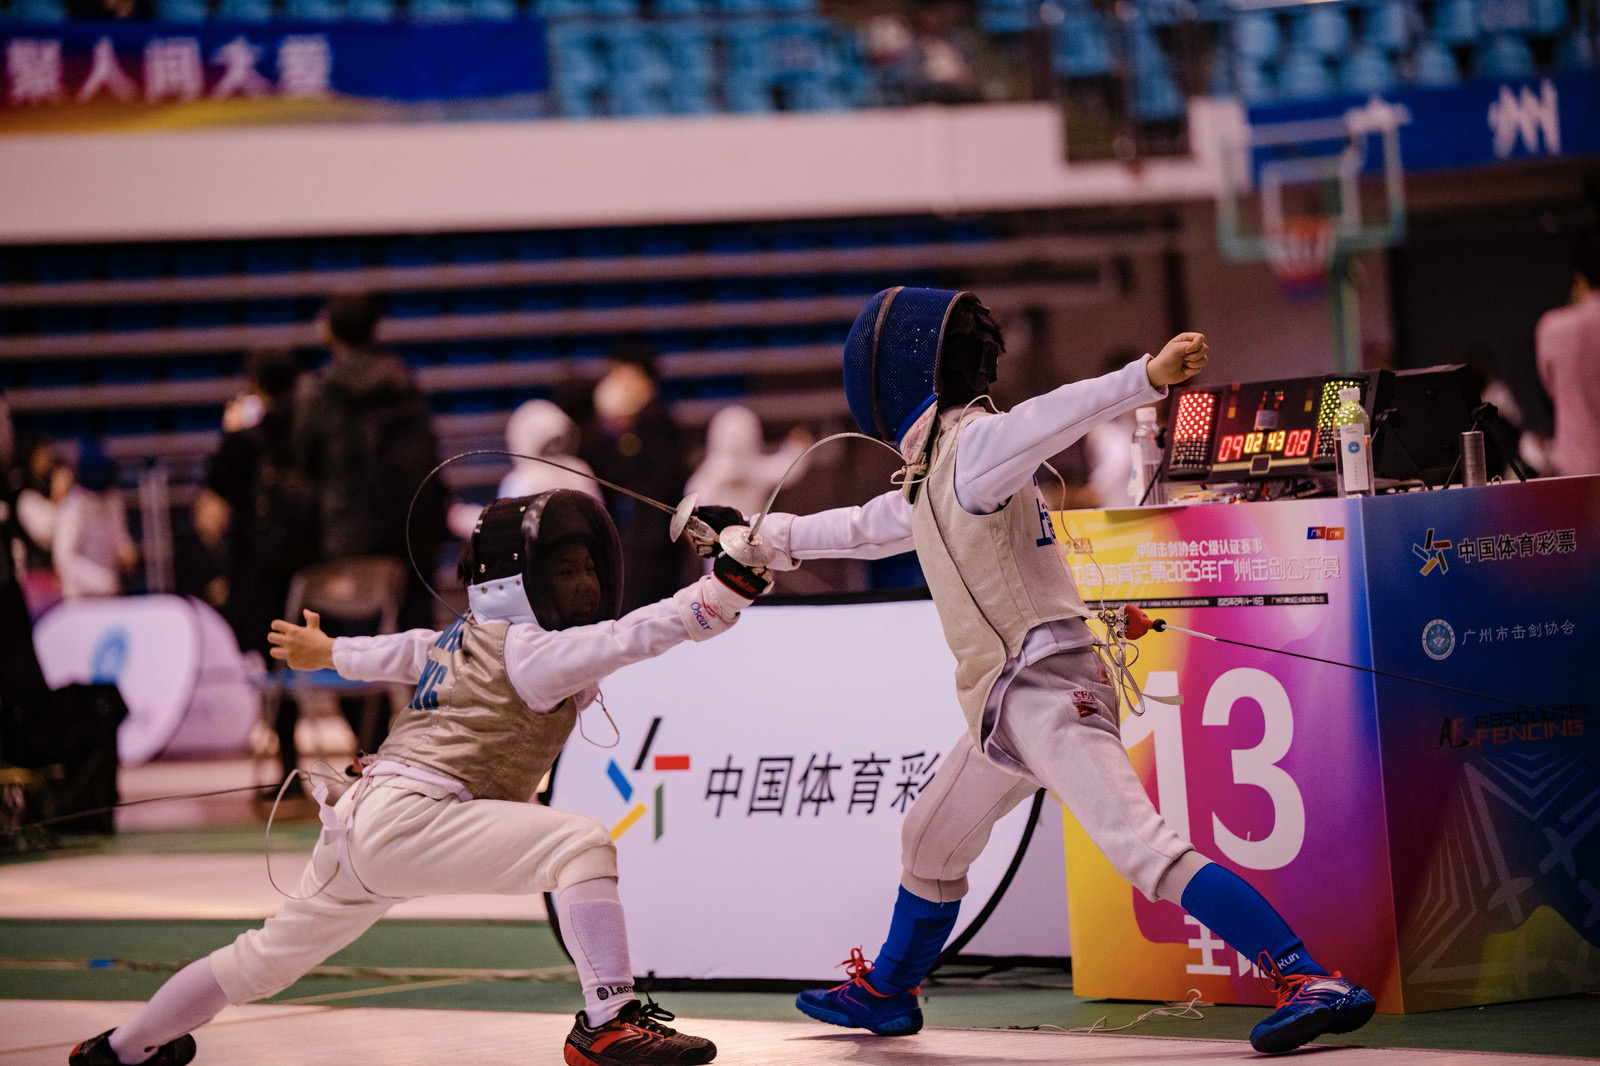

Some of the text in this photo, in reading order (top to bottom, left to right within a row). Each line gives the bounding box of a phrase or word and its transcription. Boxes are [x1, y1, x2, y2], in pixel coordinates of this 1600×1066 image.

[1217, 434, 1244, 463] 09
[1284, 428, 1312, 457] 08
[1136, 538, 1262, 558] 中国击剑协会C级认证赛事
[1457, 528, 1577, 564] 中国体育彩票
[690, 602, 712, 631] Oscar
[1462, 619, 1576, 645] 广州市击剑协会
[1476, 719, 1584, 746] FENCING
[1119, 667, 1306, 871] 13
